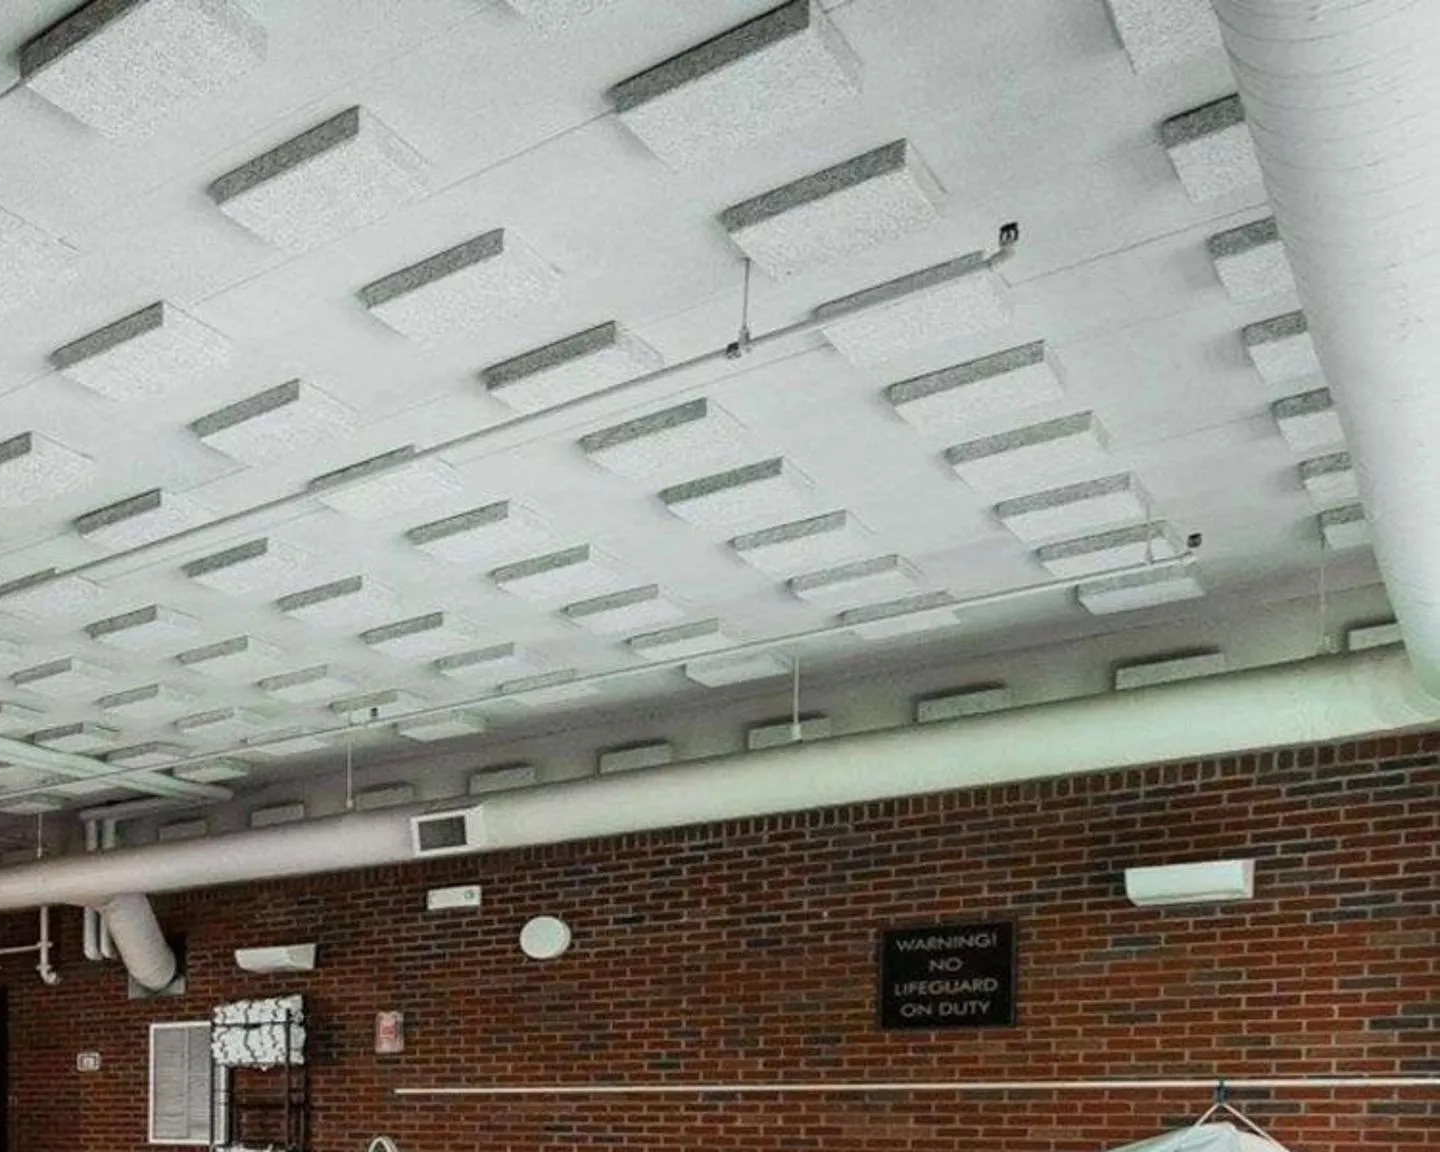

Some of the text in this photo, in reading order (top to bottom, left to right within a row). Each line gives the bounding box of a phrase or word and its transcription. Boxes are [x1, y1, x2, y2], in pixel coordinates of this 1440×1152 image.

[896, 932, 998, 952] WARNING!
[929, 957, 963, 973] NO
[893, 977, 999, 996] LIFEGUARD
[899, 1000, 992, 1018] ON DUTY
